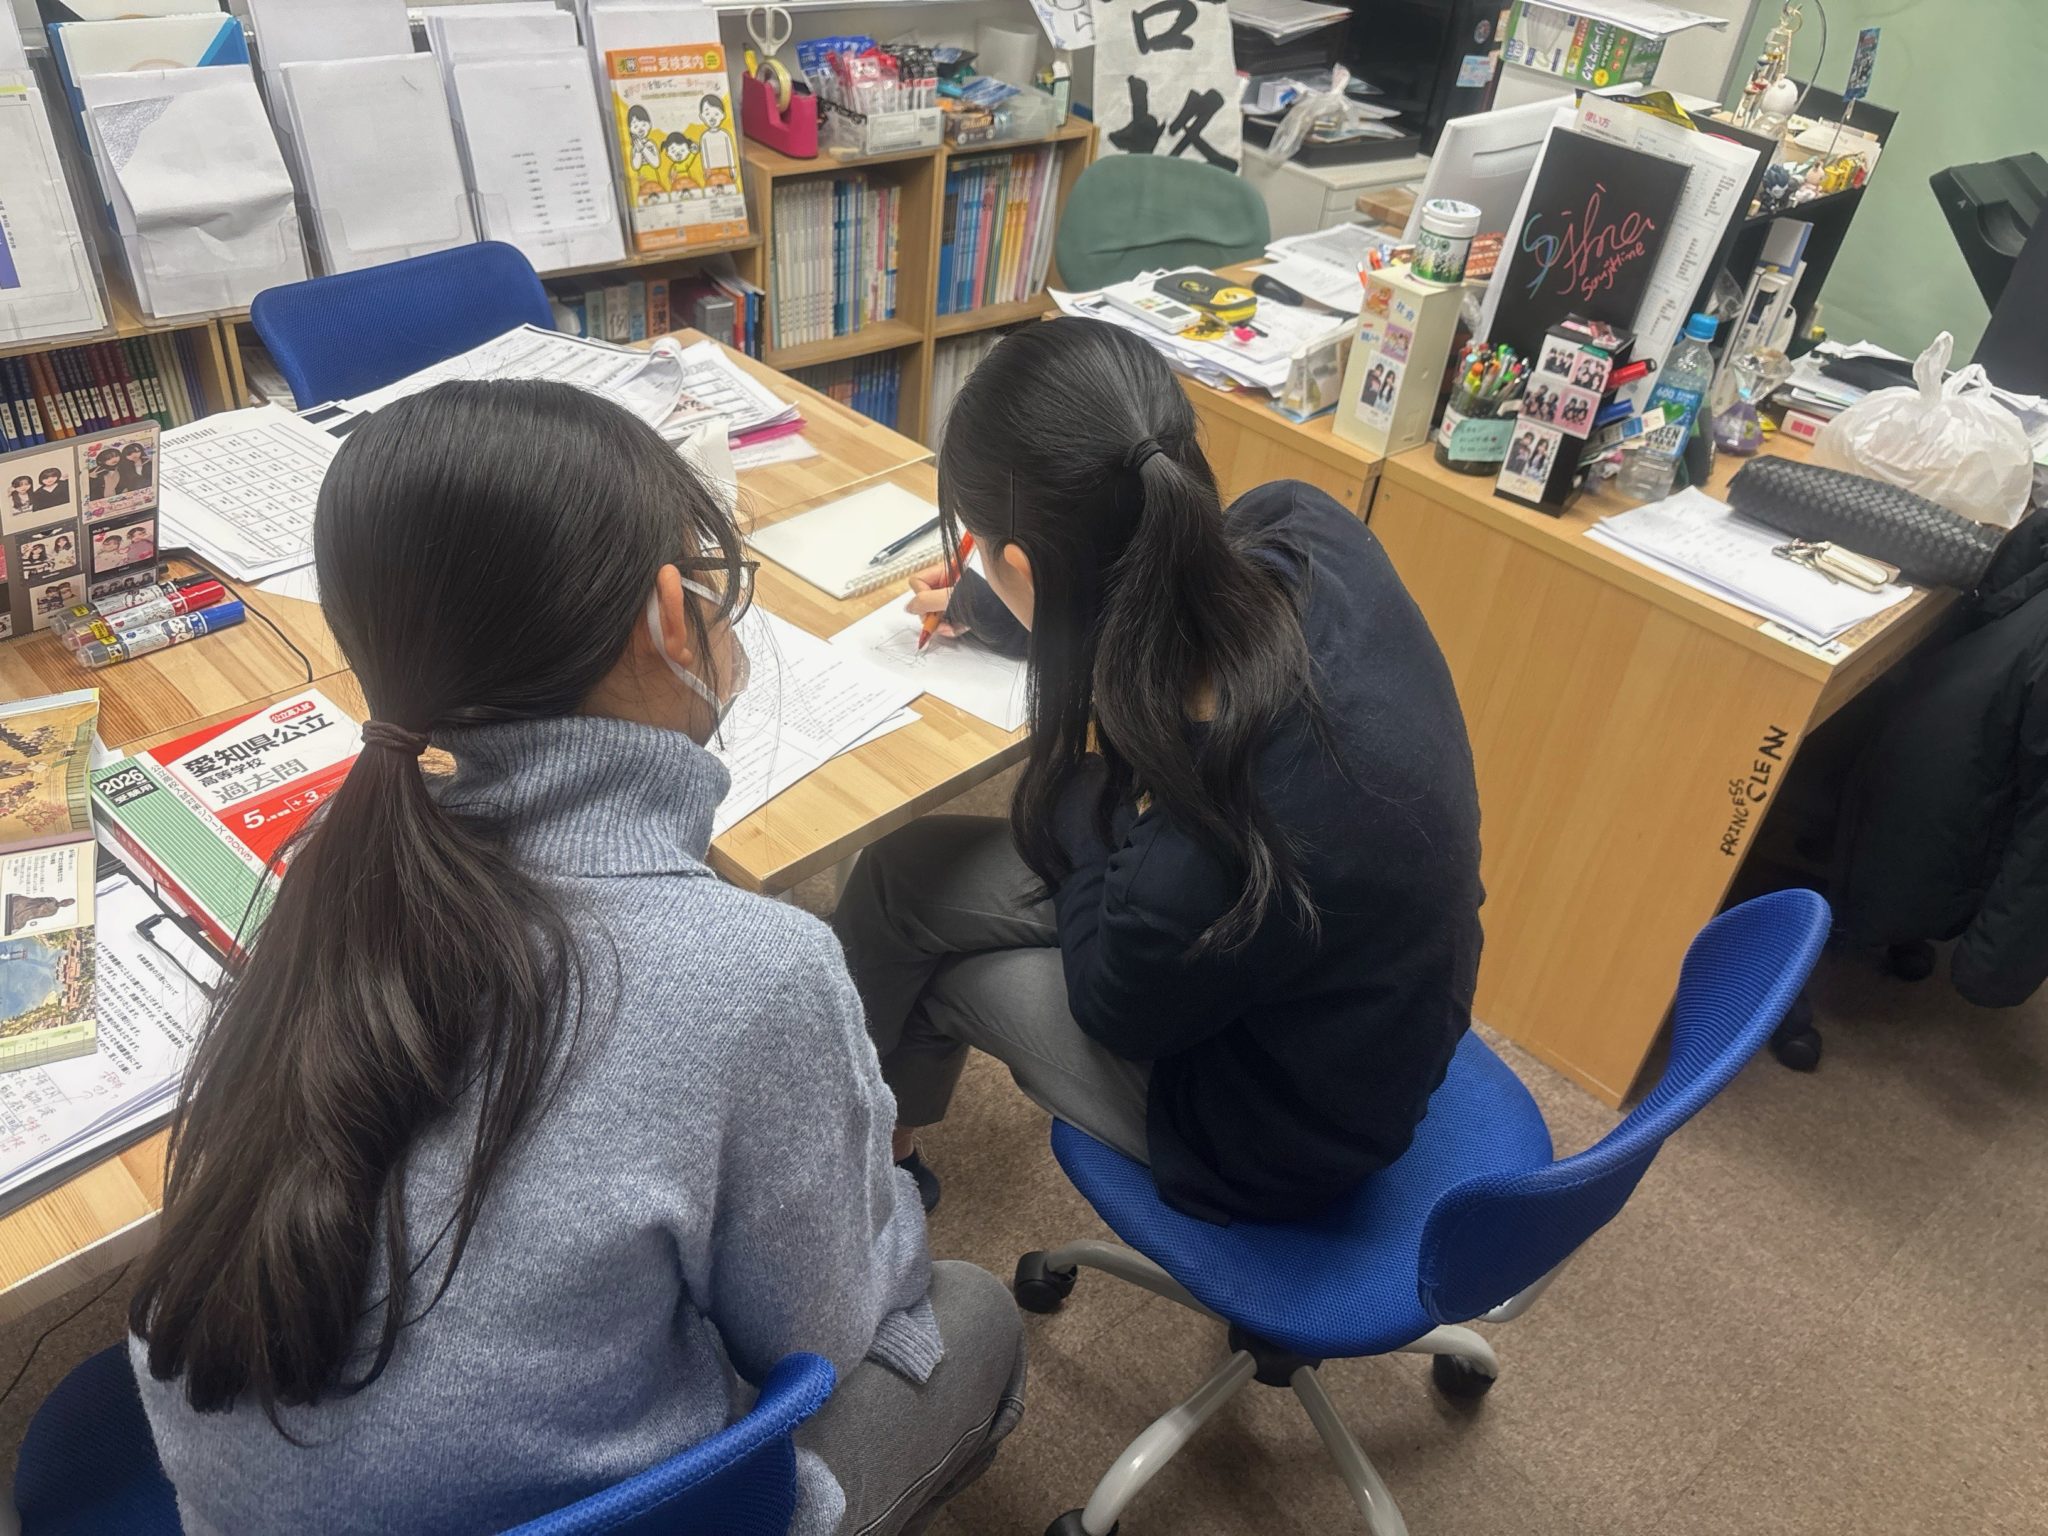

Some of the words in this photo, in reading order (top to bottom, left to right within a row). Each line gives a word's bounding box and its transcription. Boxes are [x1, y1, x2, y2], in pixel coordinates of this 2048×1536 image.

[183, 713, 335, 778] 愛知県公立
[200, 758, 267, 788] 高等学校
[1746, 725, 1789, 803] CLEAN
[212, 758, 310, 804] 過去問
[1720, 778, 1749, 857] PRINCESS
[225, 836, 253, 862] 3023
